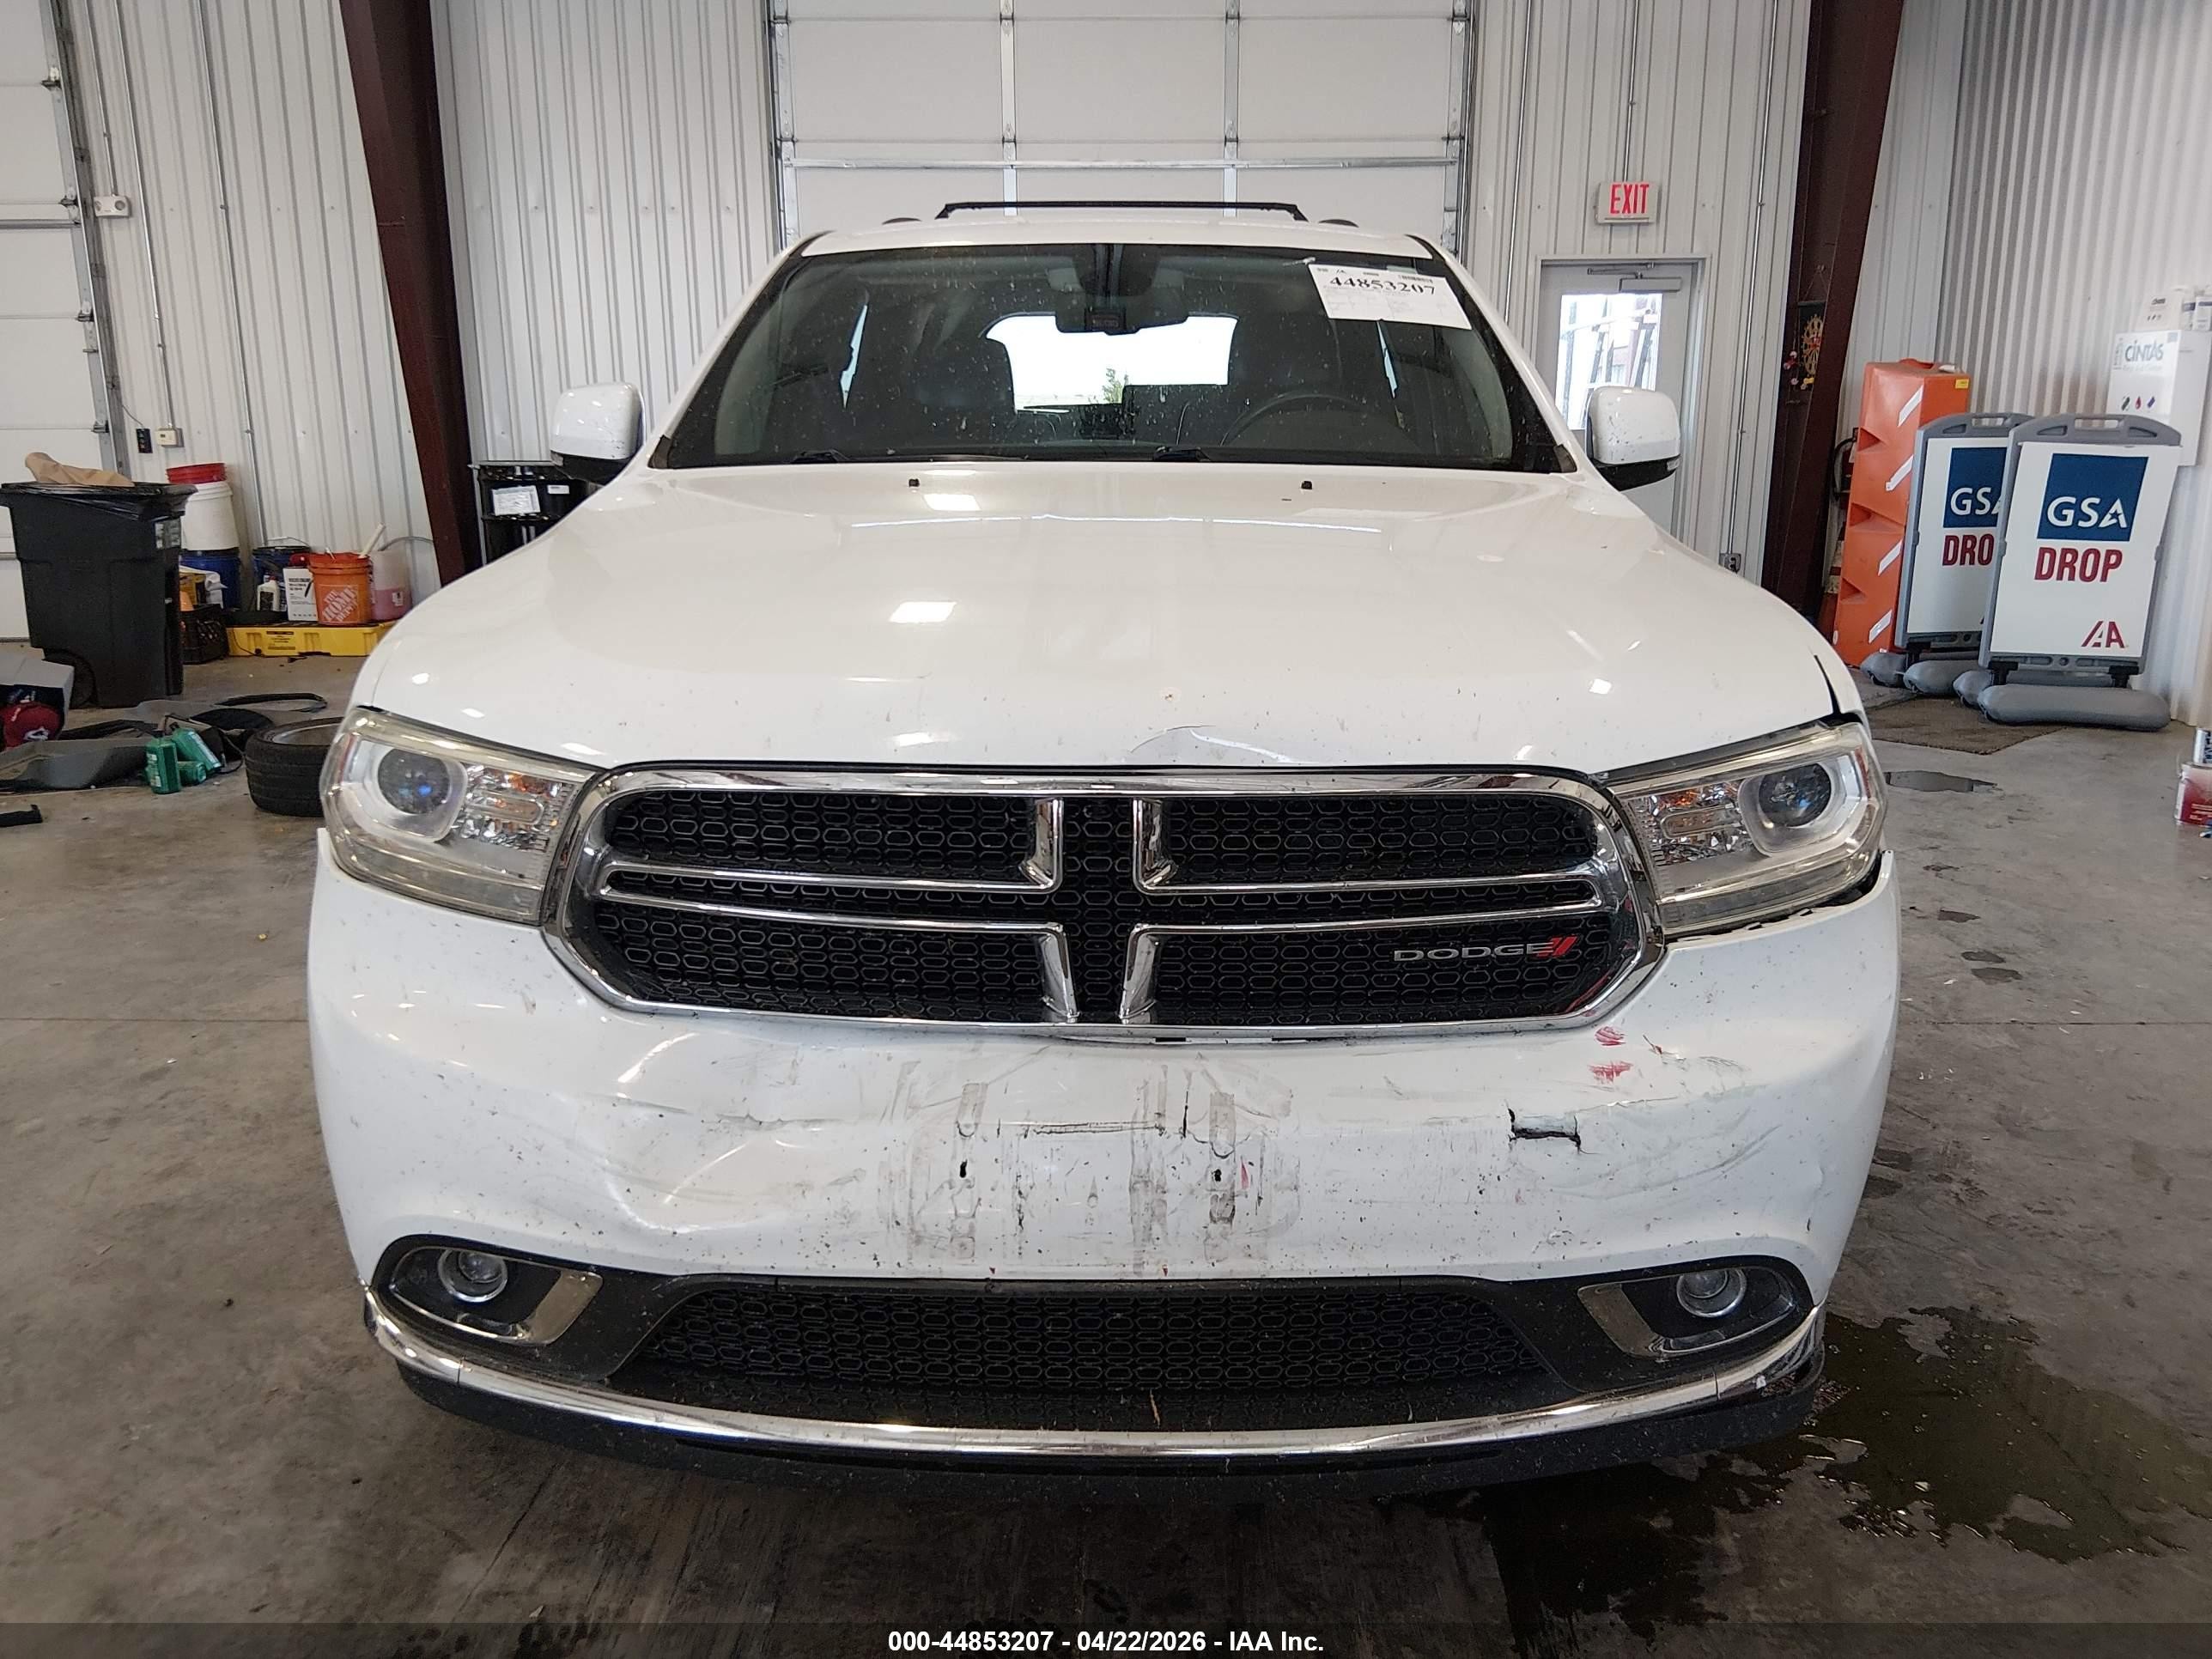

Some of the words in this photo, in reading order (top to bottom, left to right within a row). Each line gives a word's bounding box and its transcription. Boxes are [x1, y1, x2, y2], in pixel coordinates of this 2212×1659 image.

[1610, 184, 1649, 215] EXIT
[1329, 276, 1436, 295] 44853207
[2047, 496, 2127, 527] GSA
[2034, 546, 2123, 583] DROP
[321, 586, 357, 623] HOME
[1394, 942, 1554, 962] DODGE
